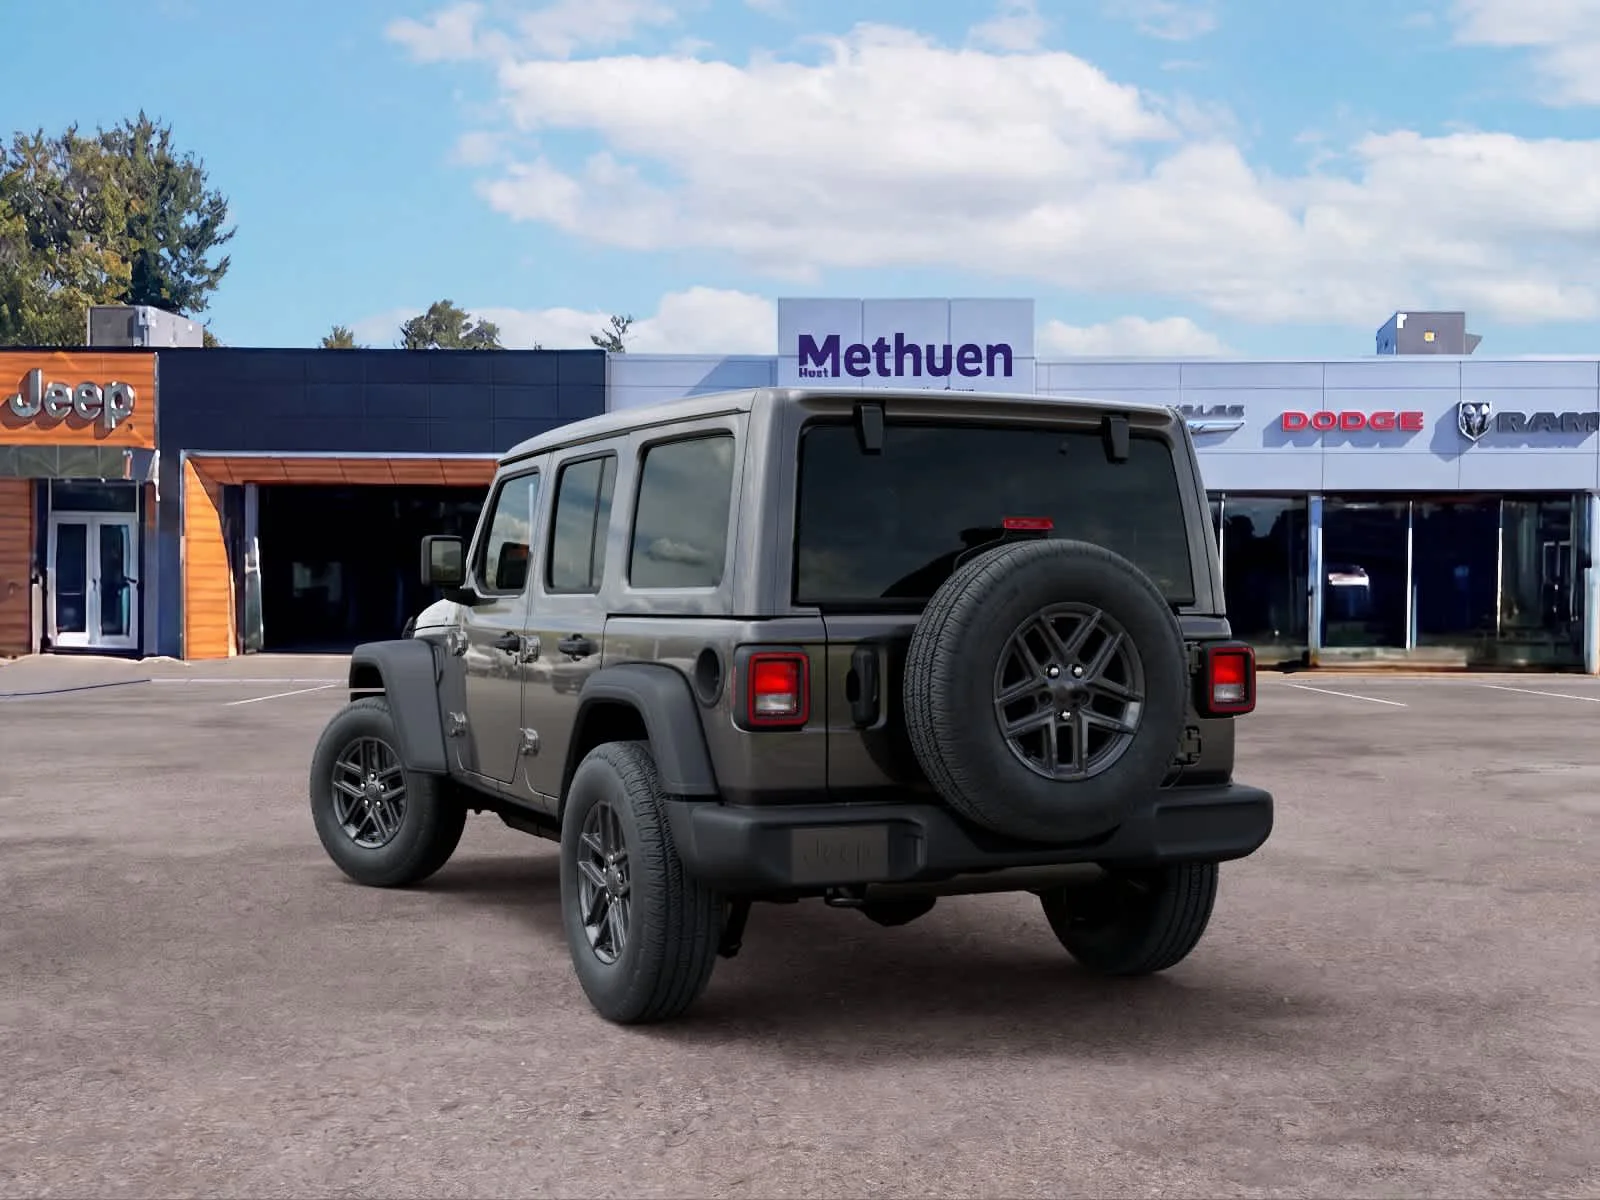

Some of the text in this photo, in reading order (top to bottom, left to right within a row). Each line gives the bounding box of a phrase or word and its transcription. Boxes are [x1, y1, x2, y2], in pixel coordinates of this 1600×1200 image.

[798, 333, 1013, 378] Methuen
[9, 367, 136, 430] Jeep
[1281, 410, 1425, 432] DODGE
[1496, 411, 1600, 433] RAM
